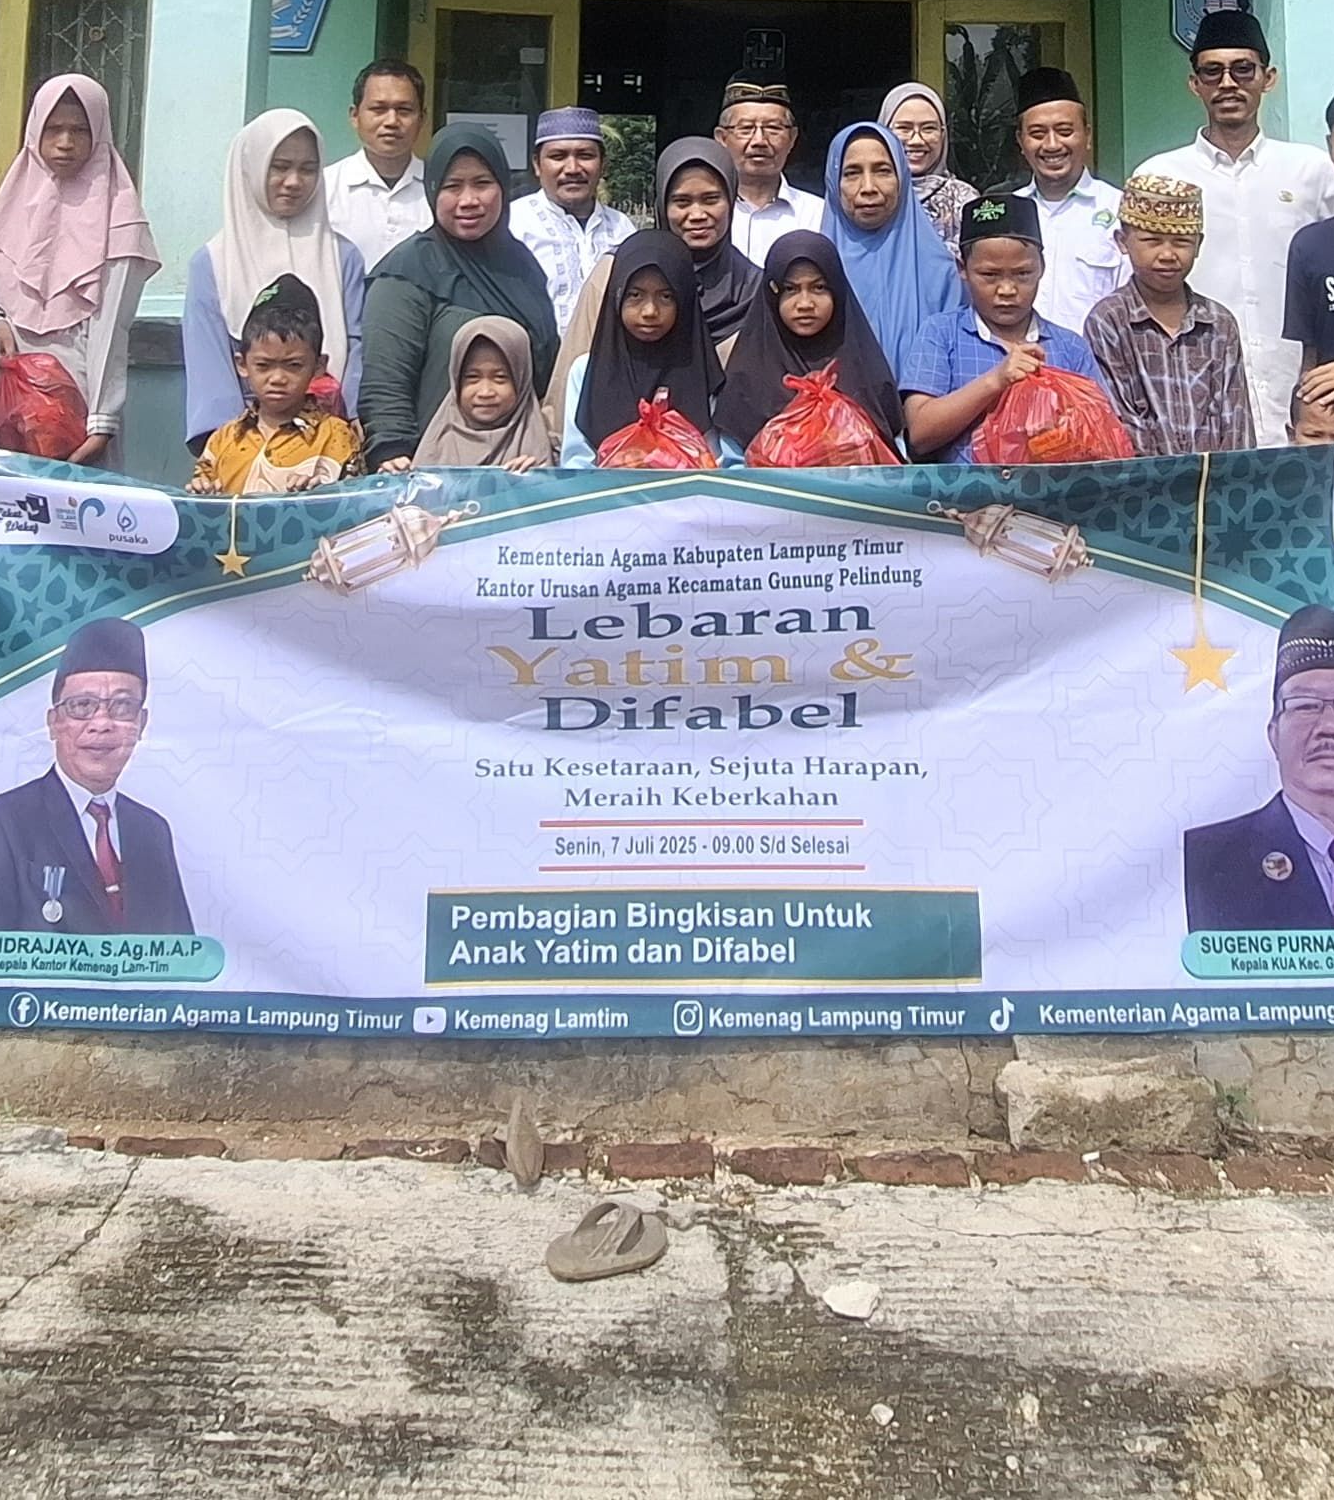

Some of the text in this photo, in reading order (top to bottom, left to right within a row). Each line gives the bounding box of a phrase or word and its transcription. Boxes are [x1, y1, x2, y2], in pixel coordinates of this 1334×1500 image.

[109, 533, 149, 545] pusaka
[497, 538, 904, 572] Kementerian Agama Kabupaten Lampung Timur
[476, 565, 923, 601] Kantor Urusan Agama Kecamatan Gunung Pelindung
[523, 602, 876, 641] Lebaran
[486, 637, 916, 686] Yatim &
[539, 691, 863, 732] Difabel
[474, 755, 929, 781] Satu Kesetaraan, Sejuta Harapan,
[563, 785, 839, 808] Meraih Keberkahan
[554, 837, 606, 858] Senin,
[611, 837, 620, 856] 7
[624, 836, 654, 855] Juli
[659, 837, 697, 855] 2025
[711, 836, 755, 855] 09.00
[759, 835, 786, 855] S/d
[790, 835, 850, 855] Selesai
[451, 902, 872, 935] Pembagian Bingkisan Untuk
[100, 940, 202, 960] S.Ag.M.A.P
[449, 937, 796, 965] Anak Yatim dan Difabel
[1200, 936, 1272, 954] SUGENG
[31, 957, 67, 971] Kantor
[69, 959, 118, 975] Kemenag
[122, 959, 169, 973] Lam-Tim
[1231, 958, 1268, 973] Kepala
[1271, 958, 1297, 971] KUA
[1299, 957, 1323, 971] Kec.
[43, 1001, 404, 1032] Kementerian Agama Lampung Timur
[454, 1007, 629, 1033] Kemenag Lamtim
[709, 1005, 966, 1031] Kemenag Lampung Timur
[1039, 1002, 1166, 1024] Kementerian
[1171, 1001, 1240, 1027] Agama
